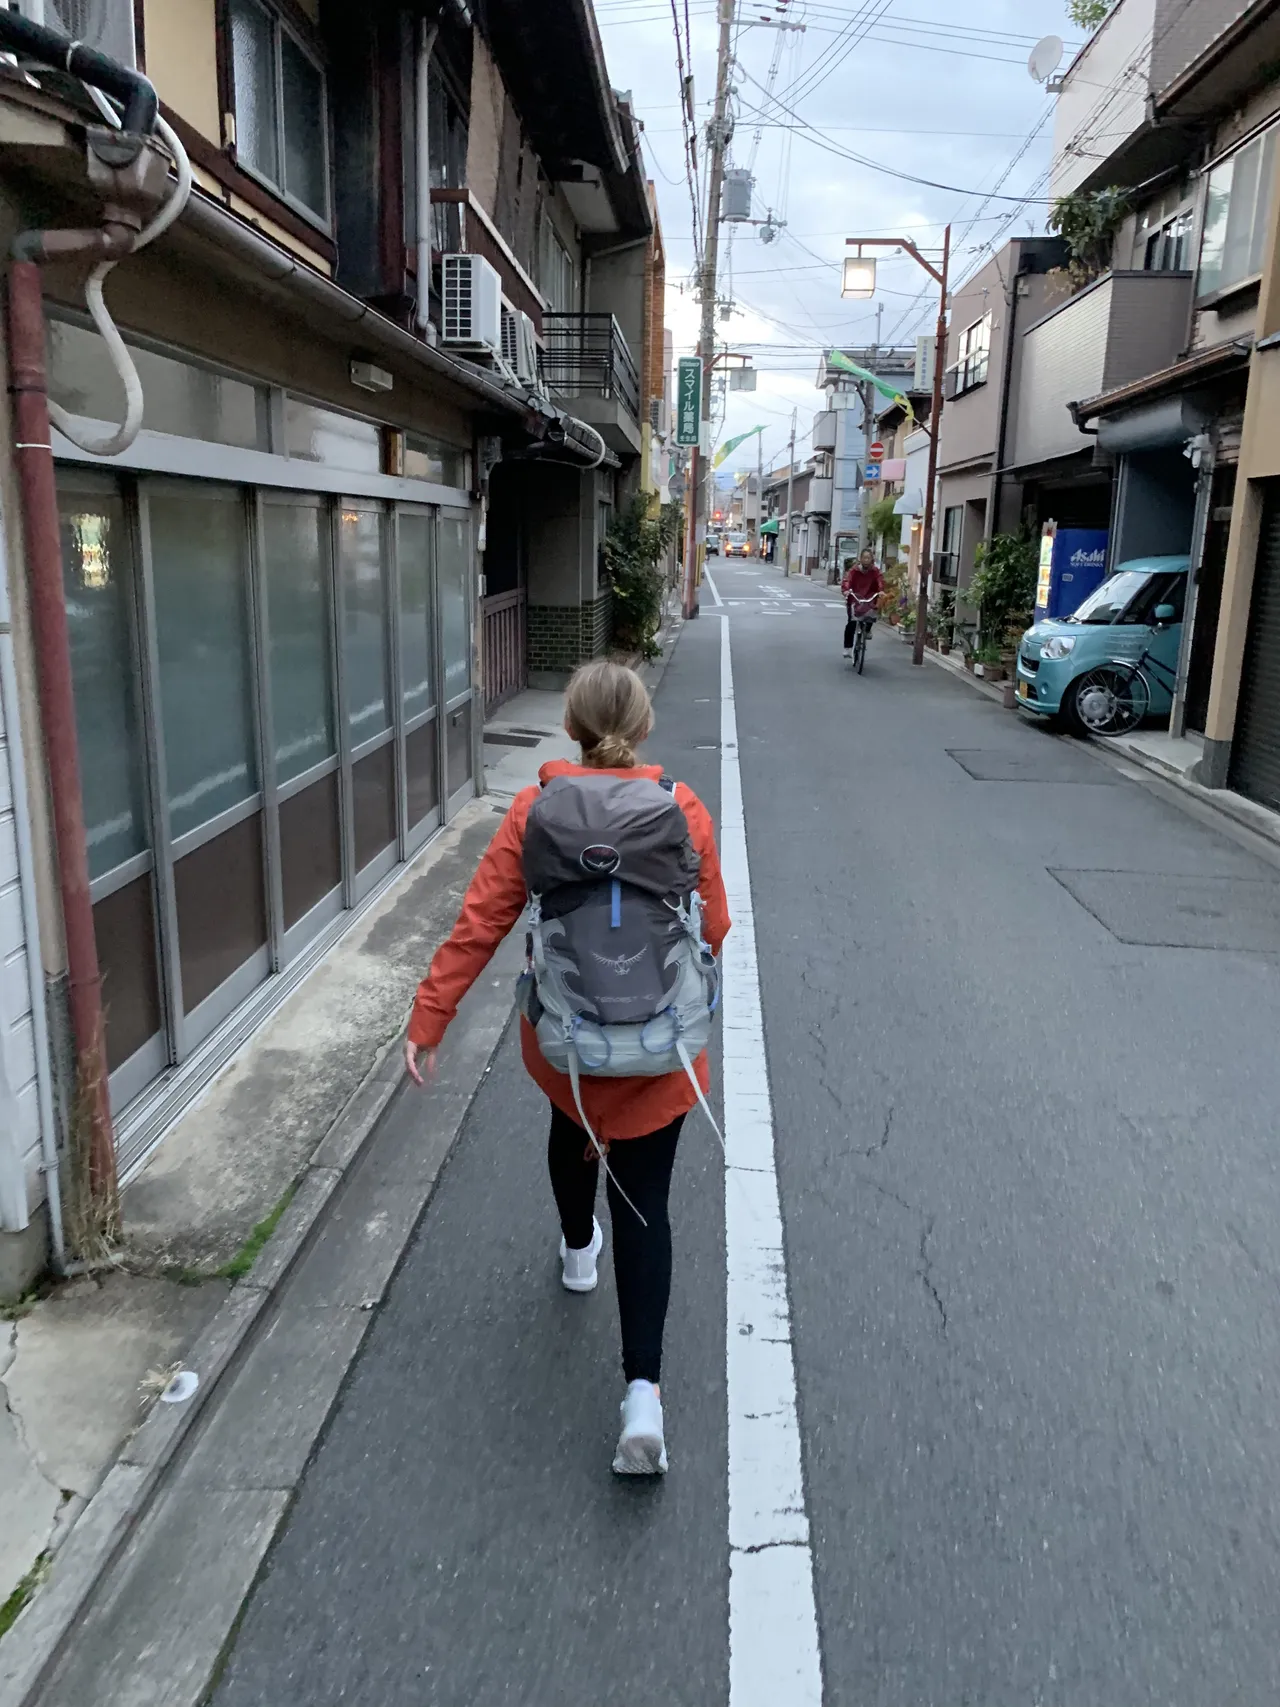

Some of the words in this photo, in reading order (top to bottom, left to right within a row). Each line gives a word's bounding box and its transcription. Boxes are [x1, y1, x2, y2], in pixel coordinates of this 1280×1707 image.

[683, 368, 695, 434] スマイル薬局
[1071, 549, 1105, 561] Asahi
